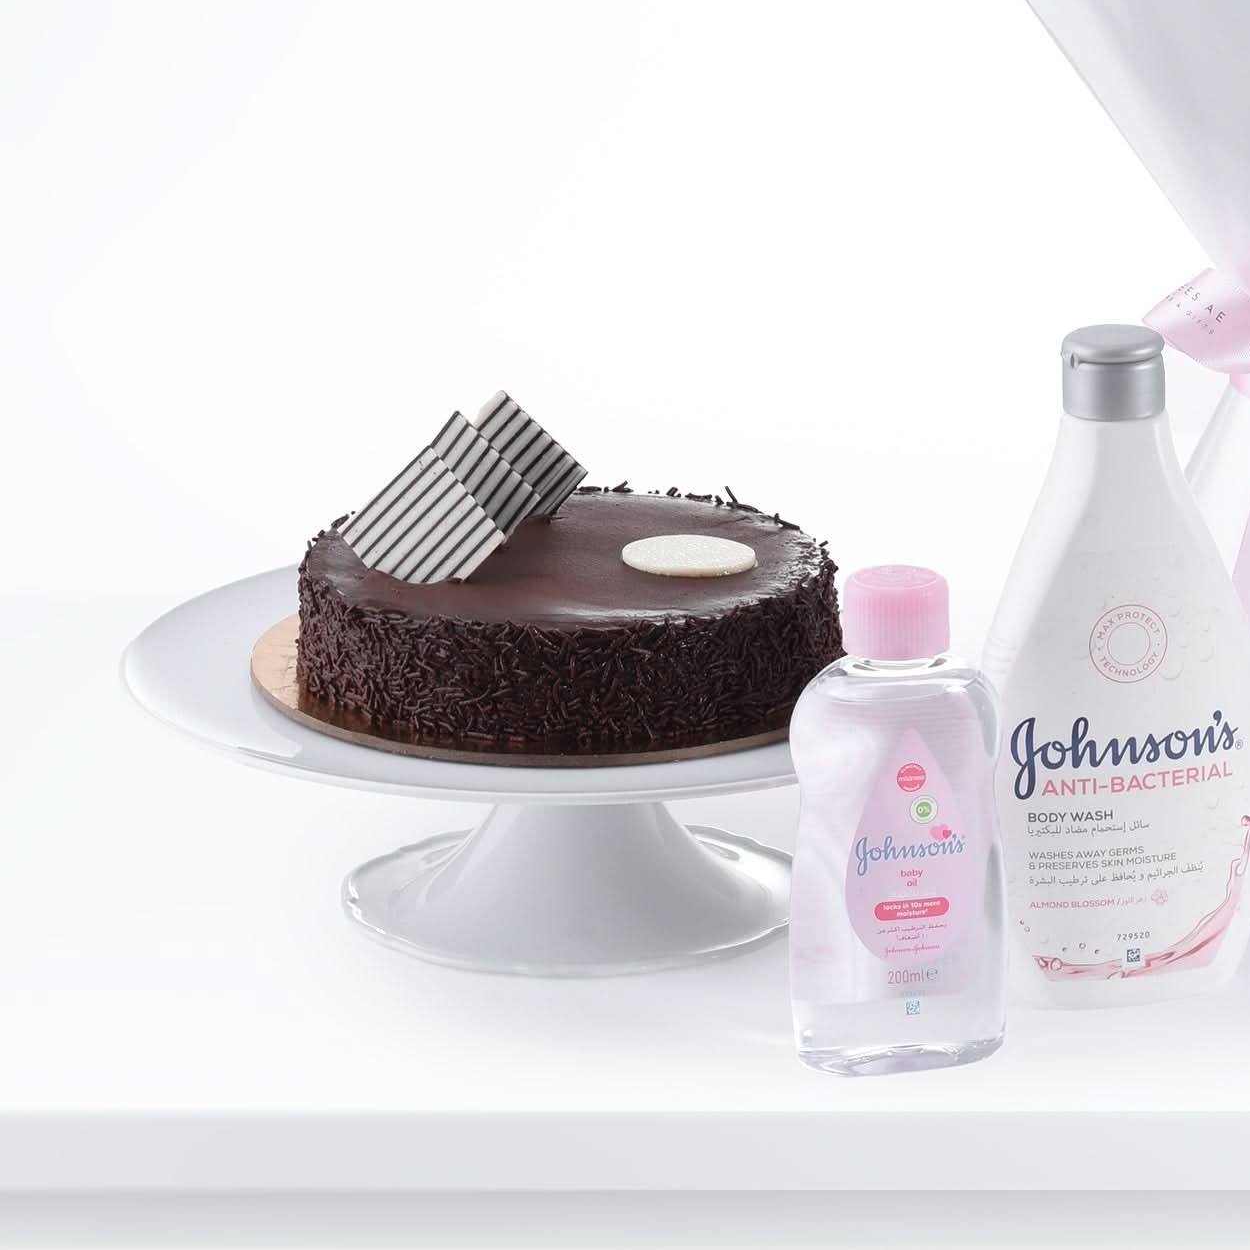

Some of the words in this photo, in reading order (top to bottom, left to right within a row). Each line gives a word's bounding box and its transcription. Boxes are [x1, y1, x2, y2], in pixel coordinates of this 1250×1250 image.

[1096, 618, 1115, 640] MAX
[1116, 611, 1161, 635] PROTECT
[1099, 651, 1159, 677] TECHNOLOGY
[1041, 761, 1233, 796] ANTI-BACTERIAL
[1028, 812, 1067, 823] BODY
[1070, 810, 1114, 821] WASH
[1028, 851, 1074, 860] WASHES
[1076, 849, 1106, 859] AWAY
[1108, 846, 1145, 857] GERMS
[1029, 862, 1036, 870] &
[1038, 860, 1099, 870] PRESERVES
[1101, 858, 1124, 868] SKIN
[1126, 852, 1177, 865] MOISTURE
[900, 869, 923, 878] baby
[907, 878, 918, 887] oil
[1029, 901, 1069, 909] ALMOND
[1071, 899, 1115, 908] BLOSSOM
[1117, 931, 1150, 941] 729520
[888, 969, 925, 984] 200ml
